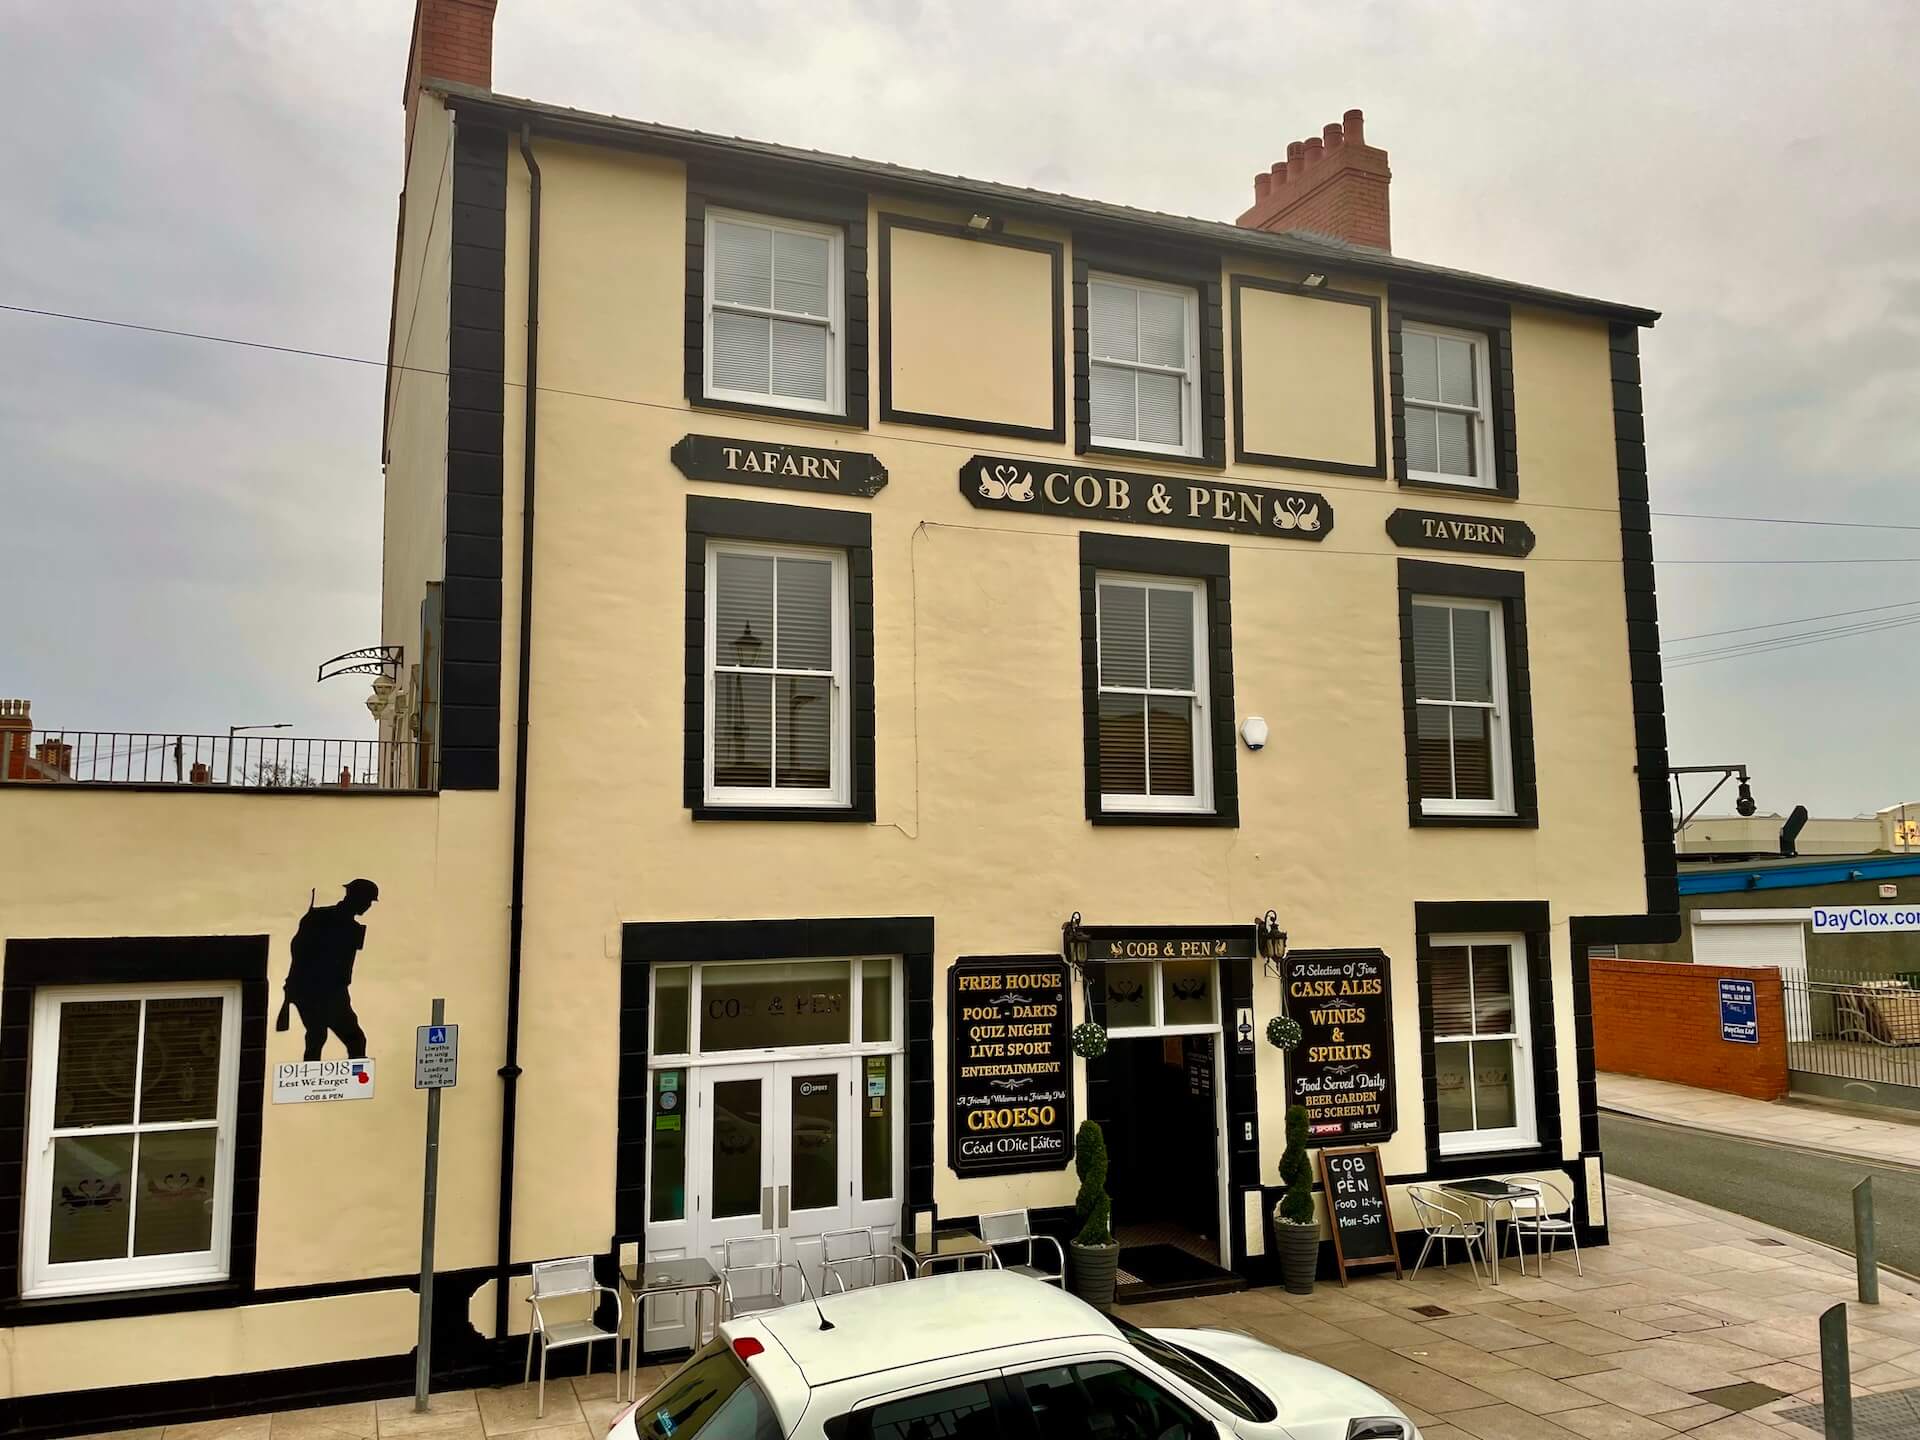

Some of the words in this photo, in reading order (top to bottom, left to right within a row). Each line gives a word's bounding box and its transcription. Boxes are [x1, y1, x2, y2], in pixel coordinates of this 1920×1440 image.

[722, 447, 842, 480] TAFARN
[1043, 472, 1131, 510] COB
[1146, 482, 1173, 515] &
[1187, 486, 1265, 526] PEN
[1422, 519, 1505, 545] TAVERN
[1814, 909, 1920, 931] DayClox.co
[1126, 942, 1158, 957] COB
[1163, 941, 1176, 957] &
[1181, 941, 1211, 957] PEN
[1292, 964, 1305, 977] A
[1306, 964, 1341, 977] Selection
[1343, 962, 1356, 978] Of
[1356, 962, 1377, 977] Fine
[959, 976, 1001, 991] FREE
[1006, 974, 1062, 989] HOUSE
[1291, 981, 1336, 998] CASK
[1340, 979, 1382, 995] ALES
[963, 1007, 1002, 1020] POOL
[1013, 1005, 1057, 1018] DARTS
[1310, 1007, 1366, 1025] WINES
[970, 1026, 1005, 1042] QUIZ
[1008, 1023, 1052, 1037] NIGHT
[1332, 1026, 1345, 1042] &
[970, 1044, 1005, 1058] LIVE
[1007, 1042, 1052, 1056] SPORT
[1309, 1044, 1372, 1063] SPIRITS
[961, 1062, 1060, 1078] ENTERTAINMENT
[279, 1080, 299, 1088] Lest
[301, 1079, 318, 1087] We
[319, 1077, 349, 1087] Forget
[1295, 1077, 1320, 1095] Food
[1322, 1075, 1355, 1091] Served
[1356, 1073, 1385, 1091] Daily
[1306, 1094, 1333, 1106] BEER
[1334, 1091, 1377, 1104] GARDEN
[967, 1105, 1056, 1130] CROESO
[1324, 1105, 1364, 1118] SCREEN
[1365, 1104, 1380, 1115] TV
[962, 1140, 993, 1155] Céad
[1330, 1157, 1366, 1172] COB
[1336, 1178, 1369, 1194] PEN
